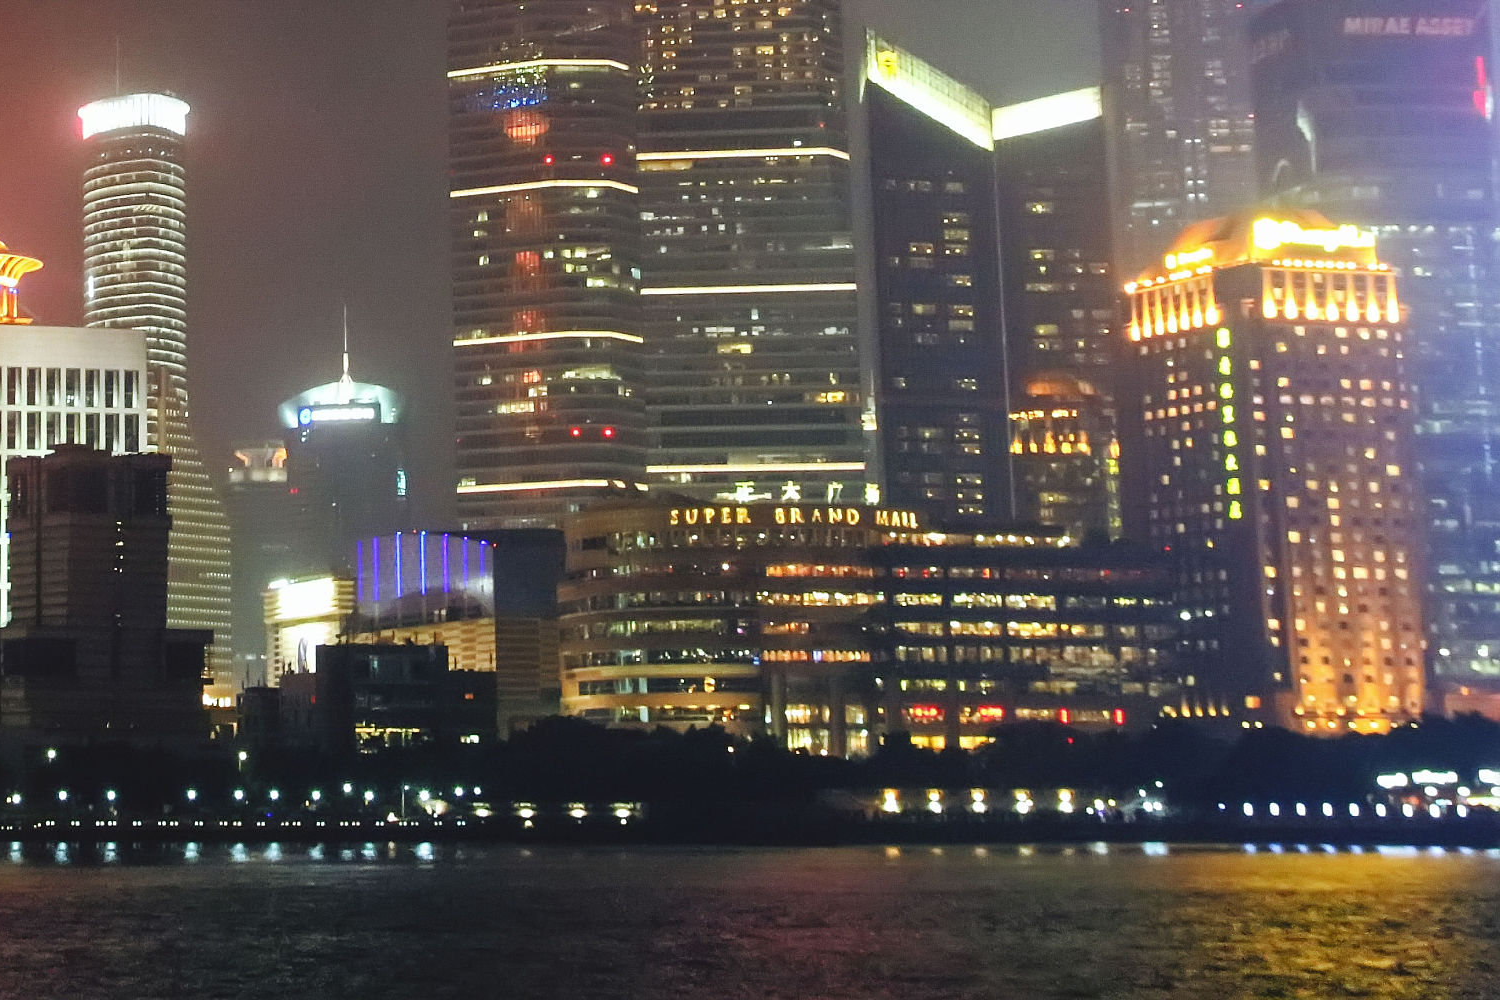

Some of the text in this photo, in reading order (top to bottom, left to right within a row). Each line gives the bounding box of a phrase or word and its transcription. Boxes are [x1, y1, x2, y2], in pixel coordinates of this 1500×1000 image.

[670, 507, 919, 529] SUPER GRAND MALL
